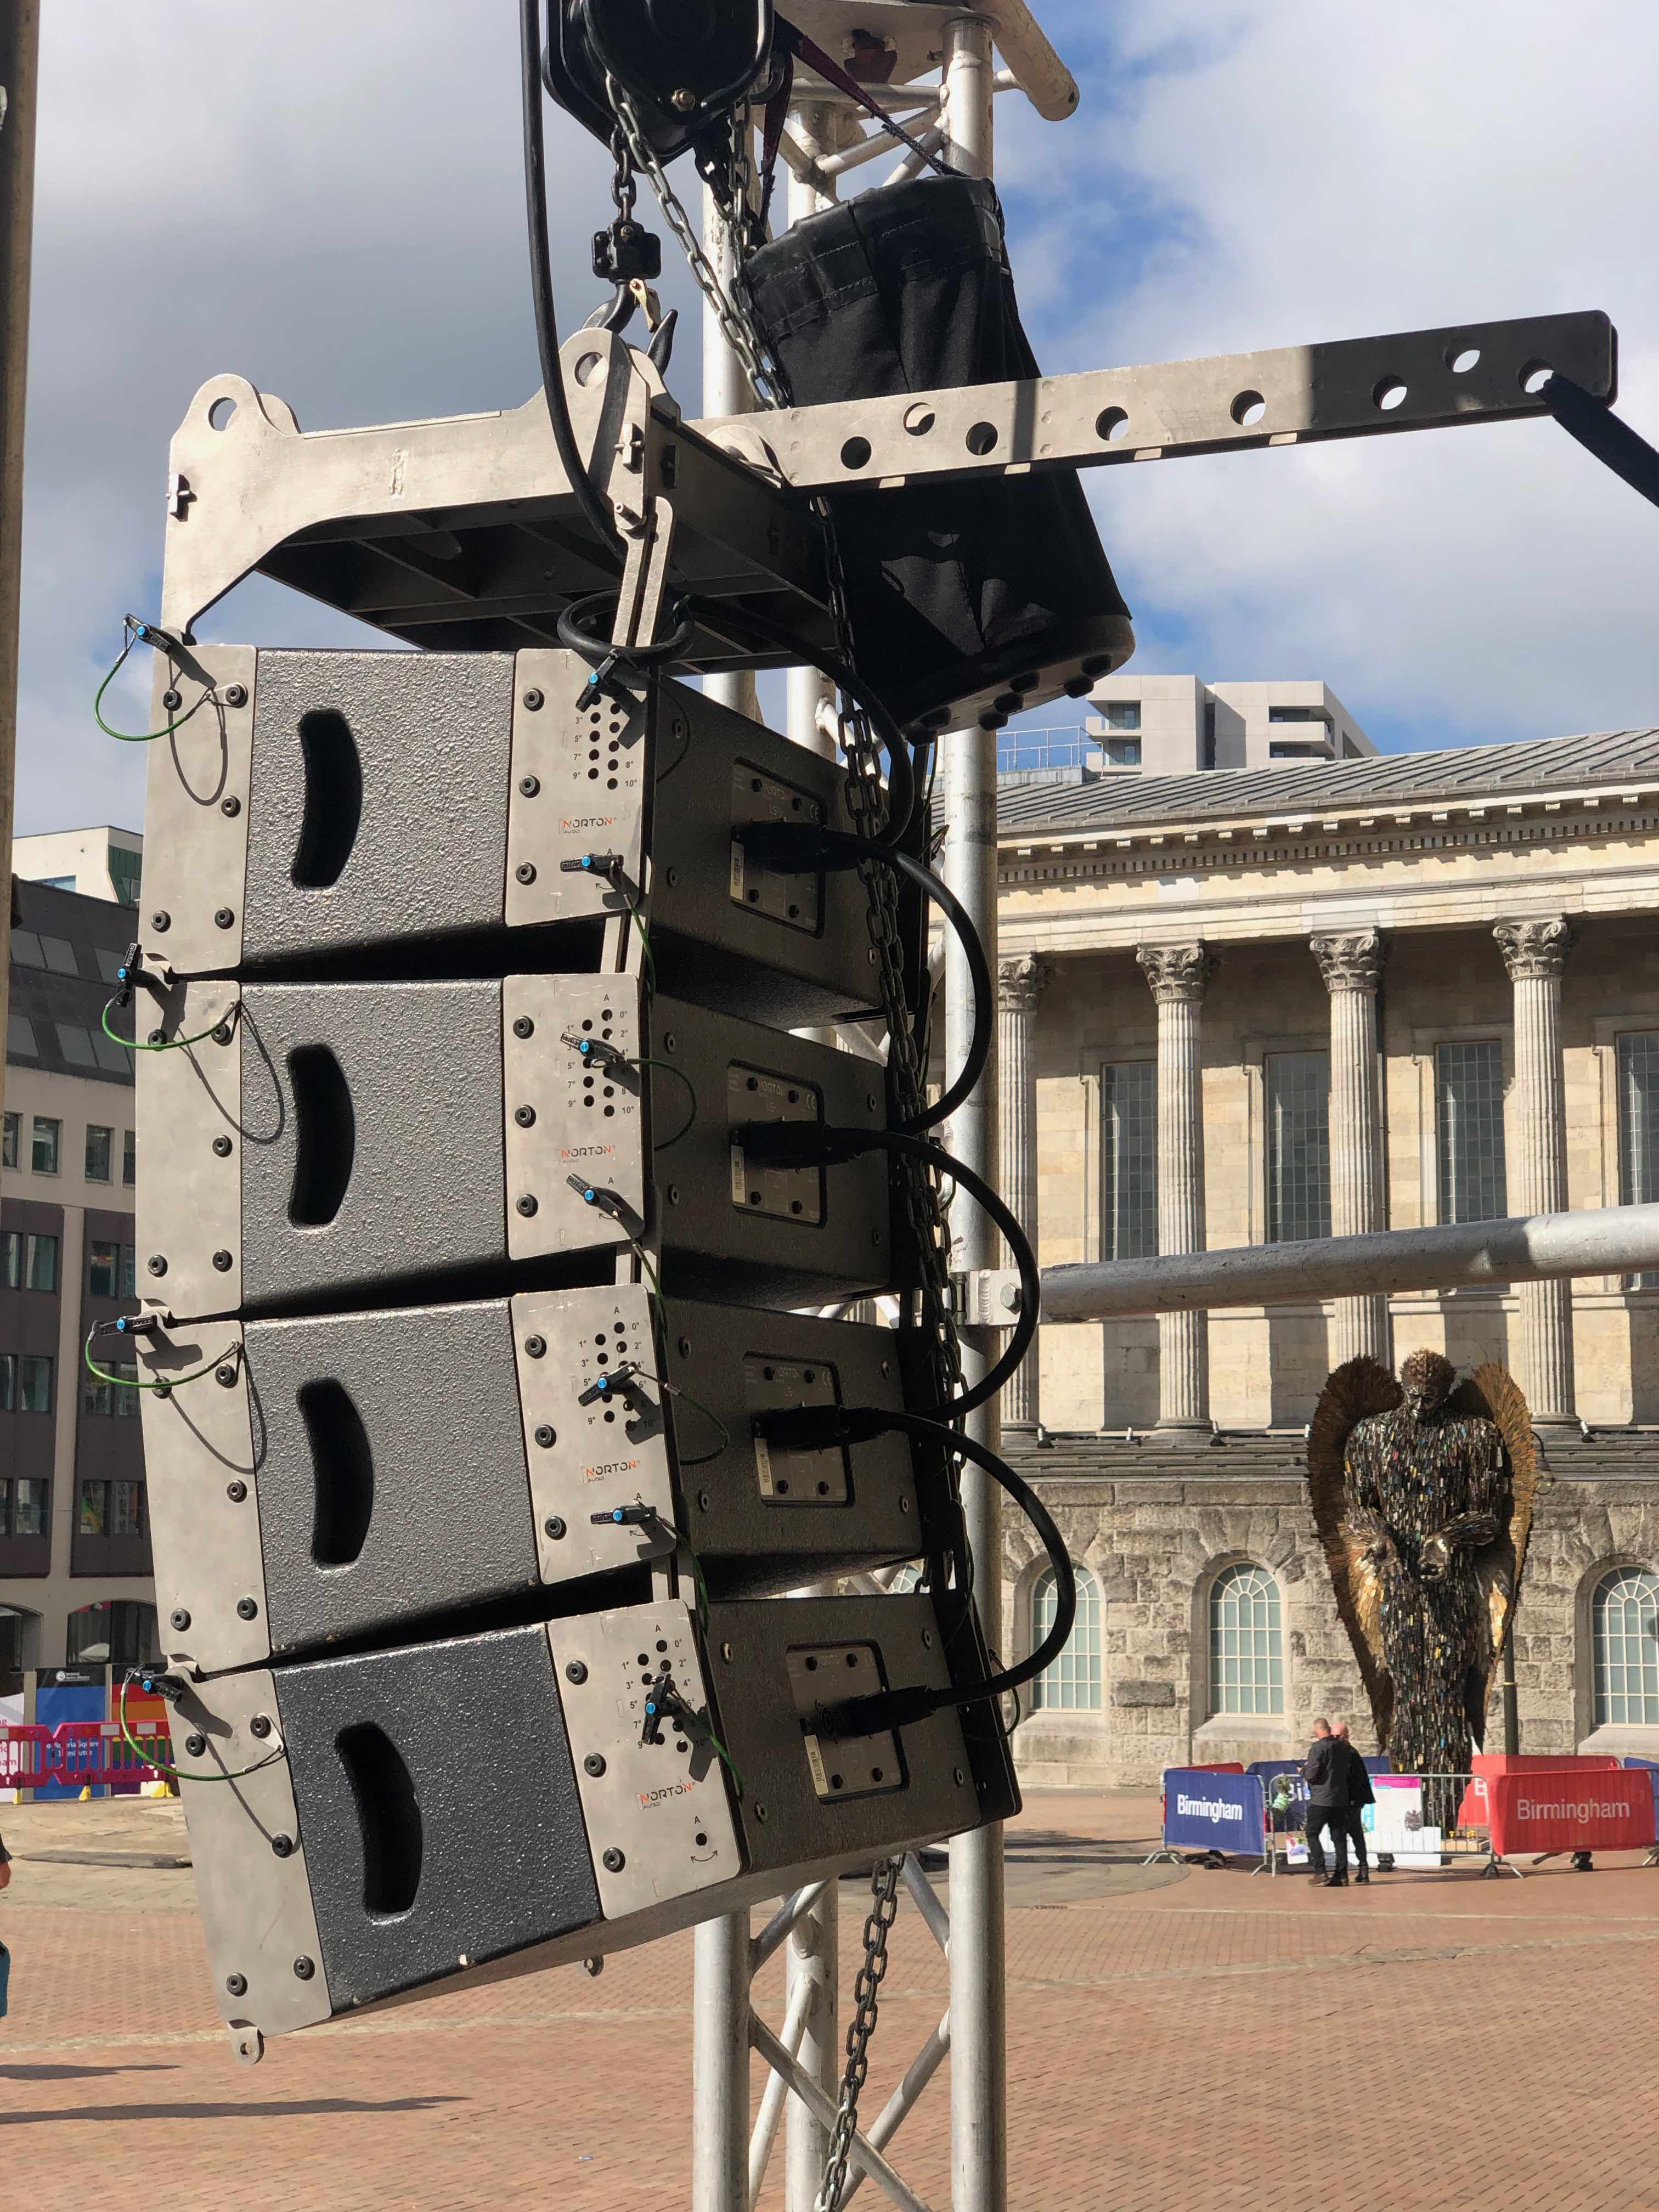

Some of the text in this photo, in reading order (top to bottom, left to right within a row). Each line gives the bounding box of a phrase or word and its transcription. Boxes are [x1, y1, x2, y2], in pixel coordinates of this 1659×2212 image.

[562, 816, 613, 828] NORTON
[562, 1145, 611, 1157] NORTON
[585, 1460, 636, 1476] NORTON
[641, 1782, 692, 1802] NORTON
[1177, 1793, 1243, 1824] Birmingham
[1517, 1798, 1630, 1824] Birmingham
